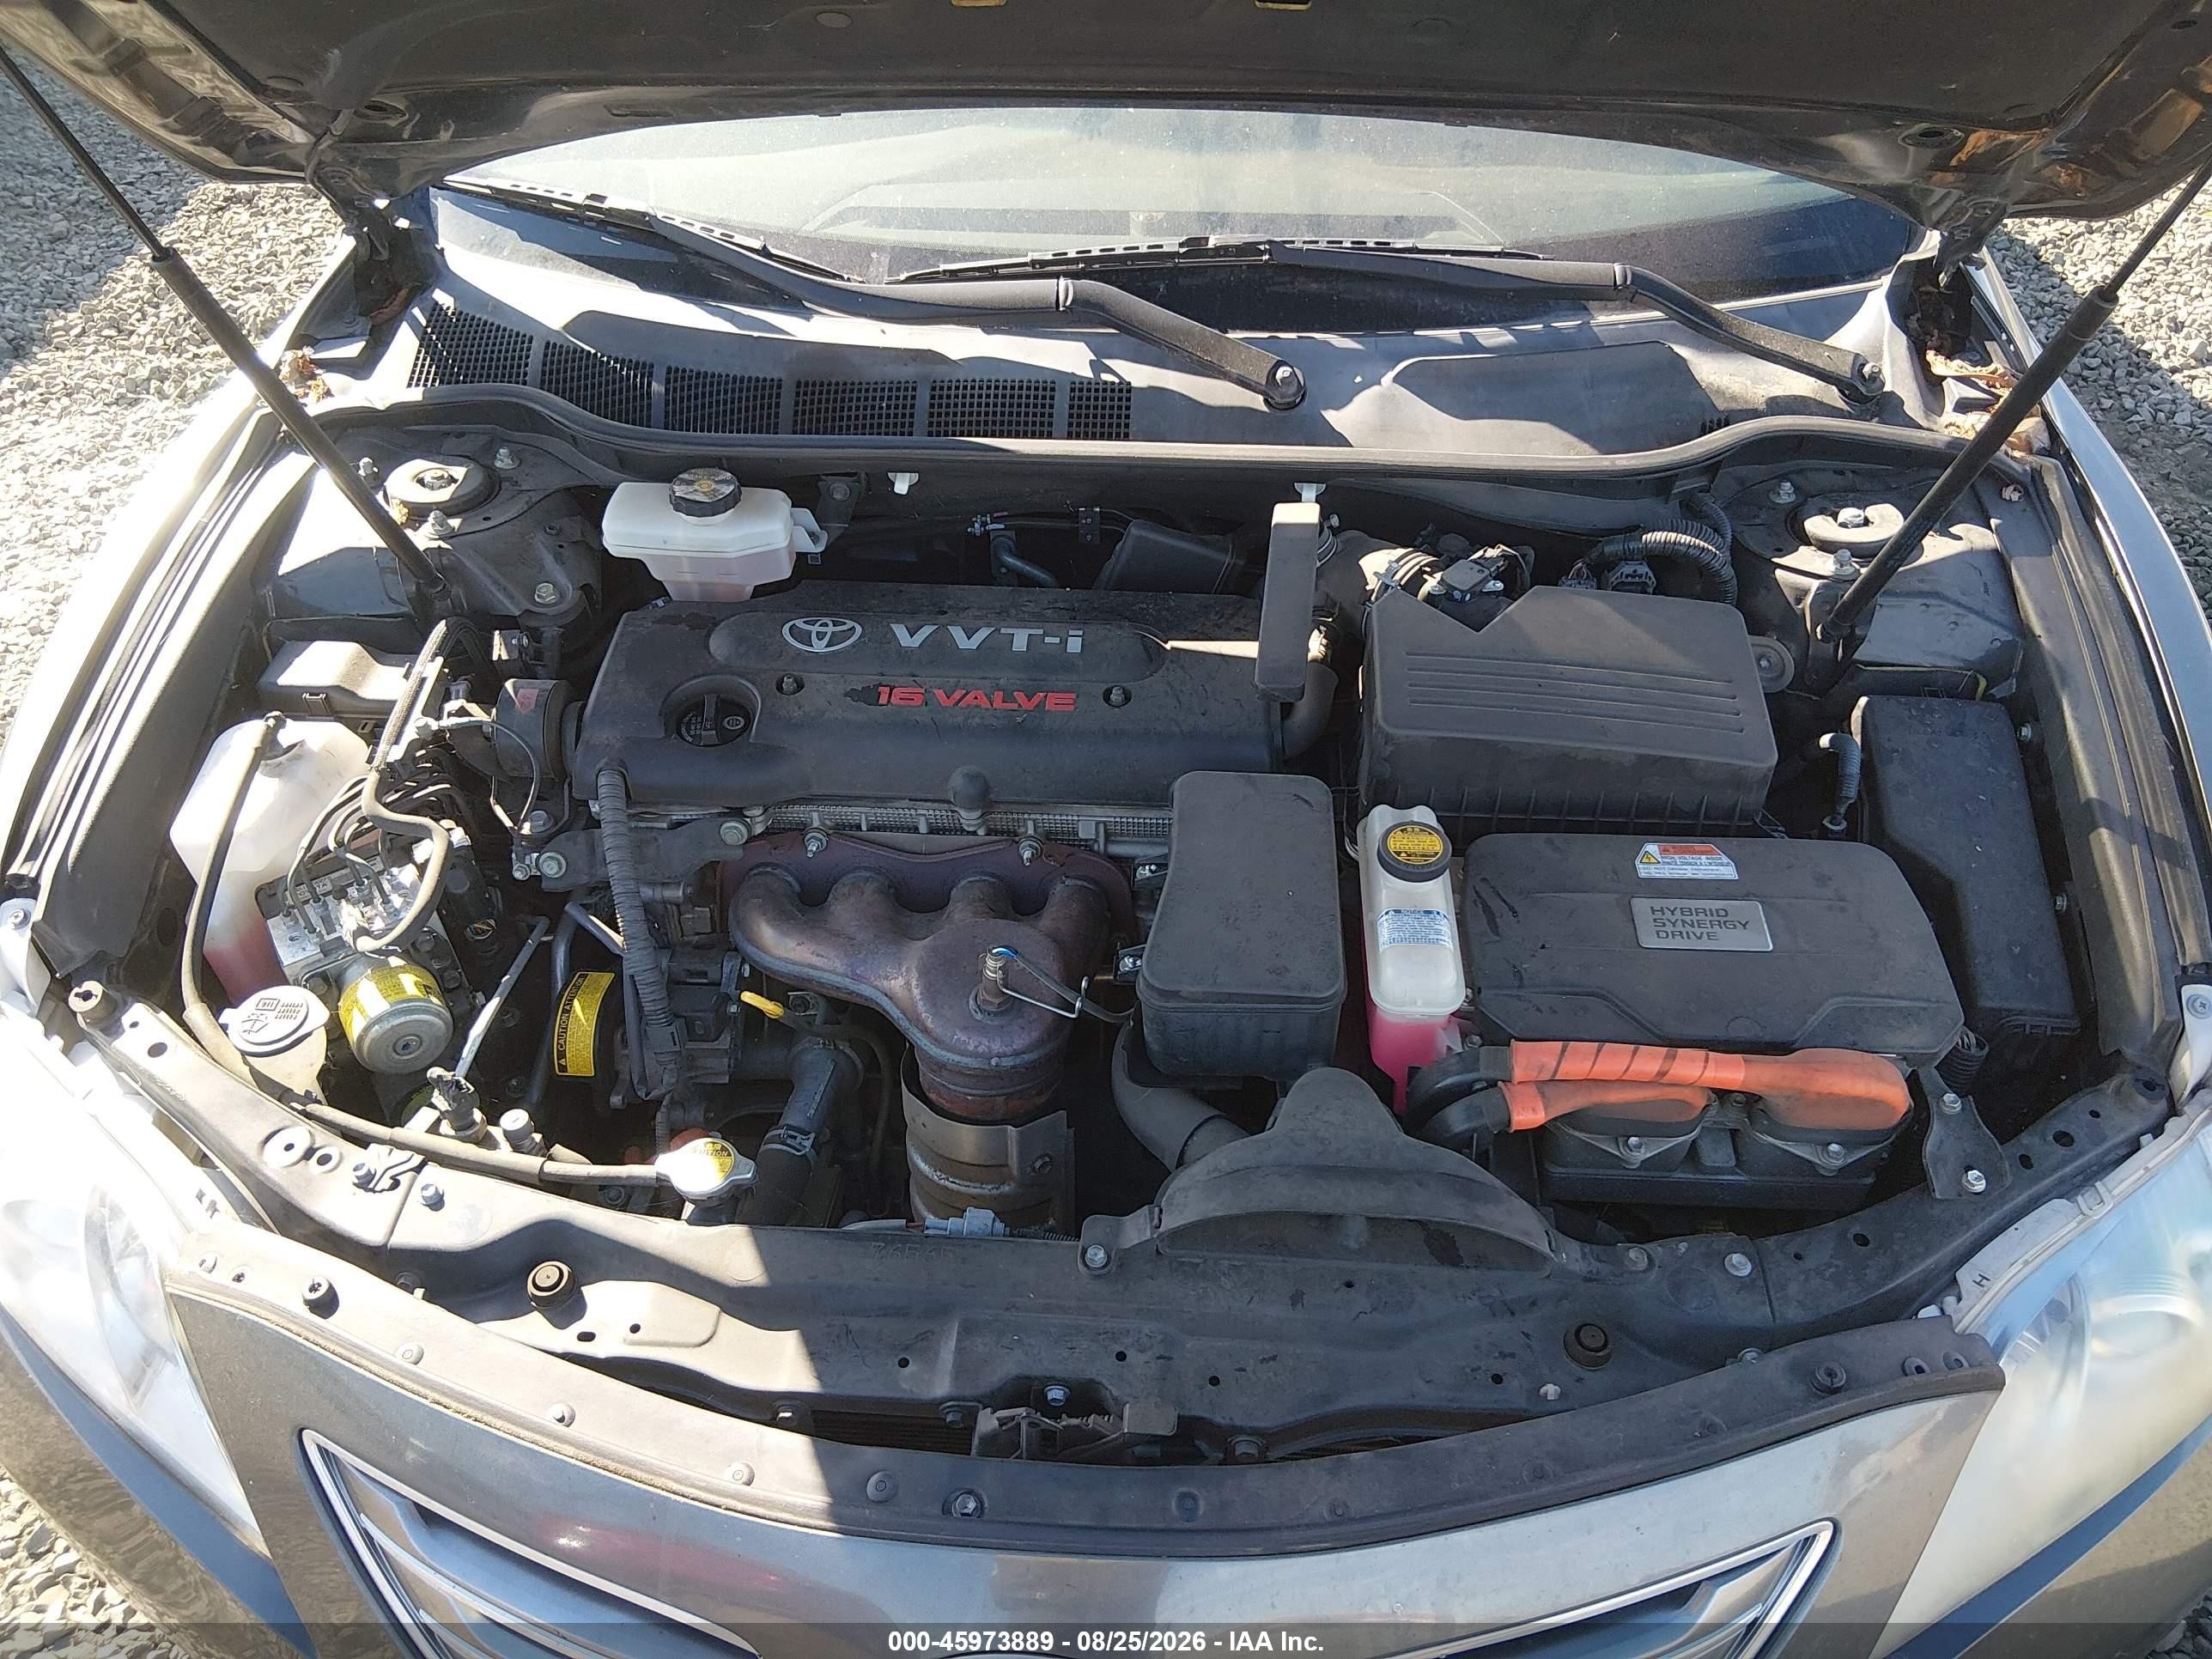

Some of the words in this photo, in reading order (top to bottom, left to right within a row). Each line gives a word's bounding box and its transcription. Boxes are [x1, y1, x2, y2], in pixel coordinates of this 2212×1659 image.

[890, 623, 1084, 653] VVT-i
[878, 686, 926, 707] 16
[933, 688, 1078, 711] VALVE
[1650, 906, 1729, 918] HYBRID
[1653, 918, 1750, 930] SYNERGY
[1656, 930, 1718, 941] DRIVE
[557, 1013, 569, 1051] CAUTION
